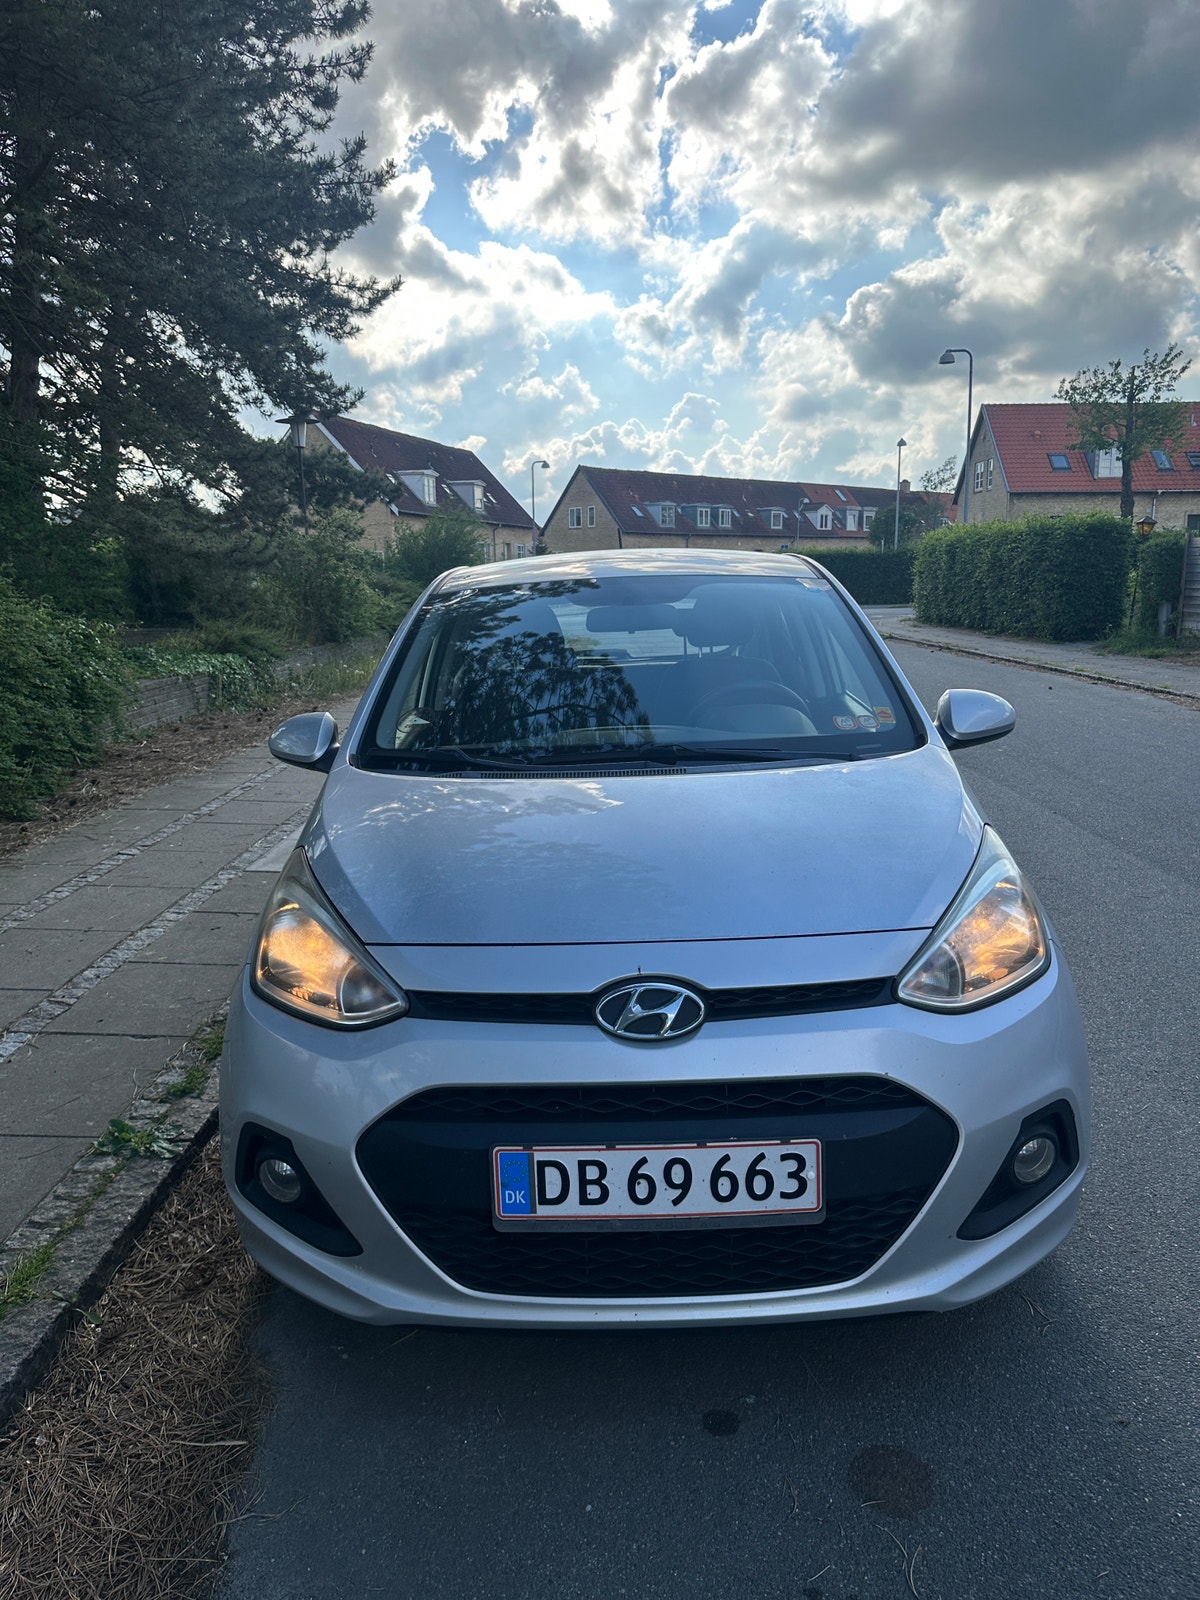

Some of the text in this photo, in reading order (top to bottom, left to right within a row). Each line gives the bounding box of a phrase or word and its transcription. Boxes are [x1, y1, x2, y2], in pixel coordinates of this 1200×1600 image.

[536, 1151, 809, 1207] DB 69 663
[505, 1190, 526, 1204] DK
